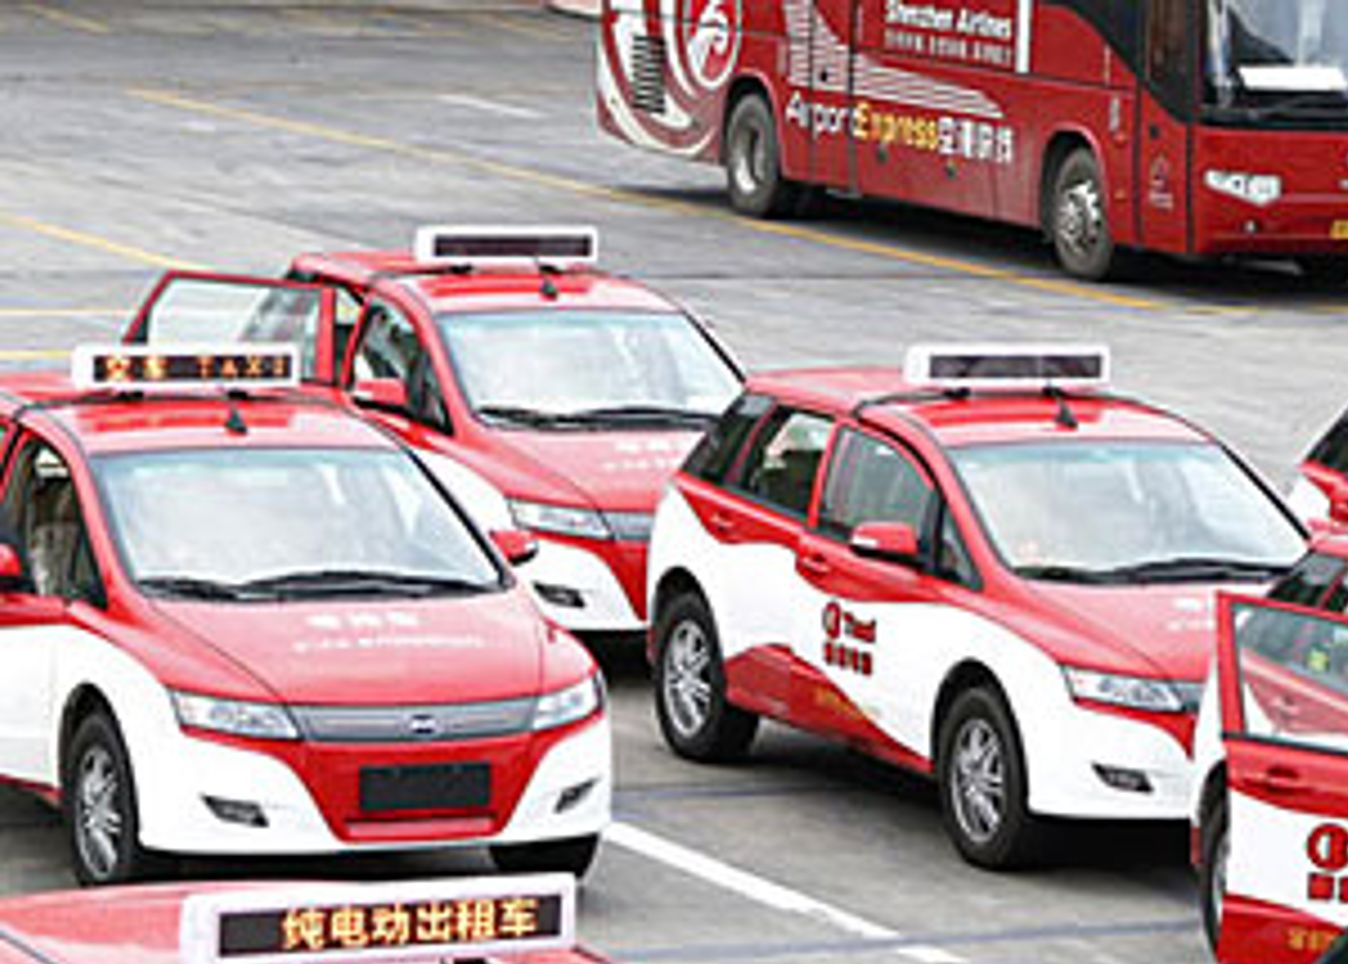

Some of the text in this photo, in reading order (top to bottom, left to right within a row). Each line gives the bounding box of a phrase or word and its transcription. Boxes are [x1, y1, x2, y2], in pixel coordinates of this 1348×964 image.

[282, 898, 540, 949] 纯电动出租车
